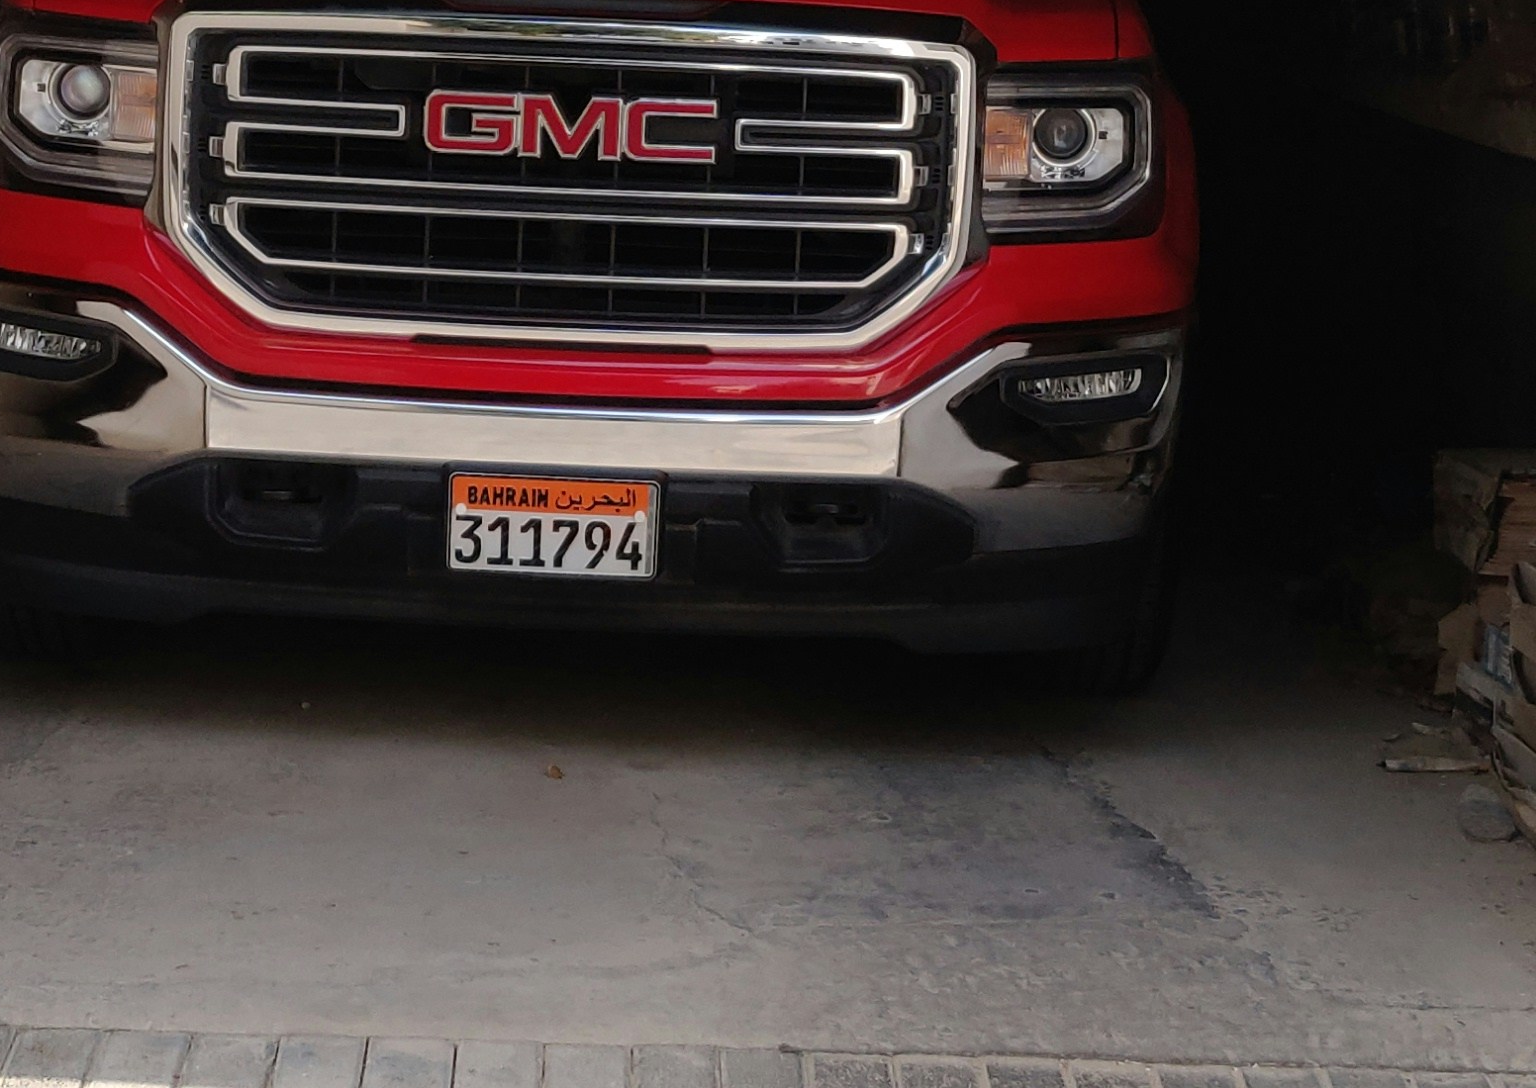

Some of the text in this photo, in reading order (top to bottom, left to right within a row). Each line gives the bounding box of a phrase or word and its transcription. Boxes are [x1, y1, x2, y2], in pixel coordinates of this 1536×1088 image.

[424, 89, 717, 164] GMC
[467, 485, 549, 508] BAHRAIN
[555, 488, 637, 512] البحرين
[454, 515, 643, 570] 311794
